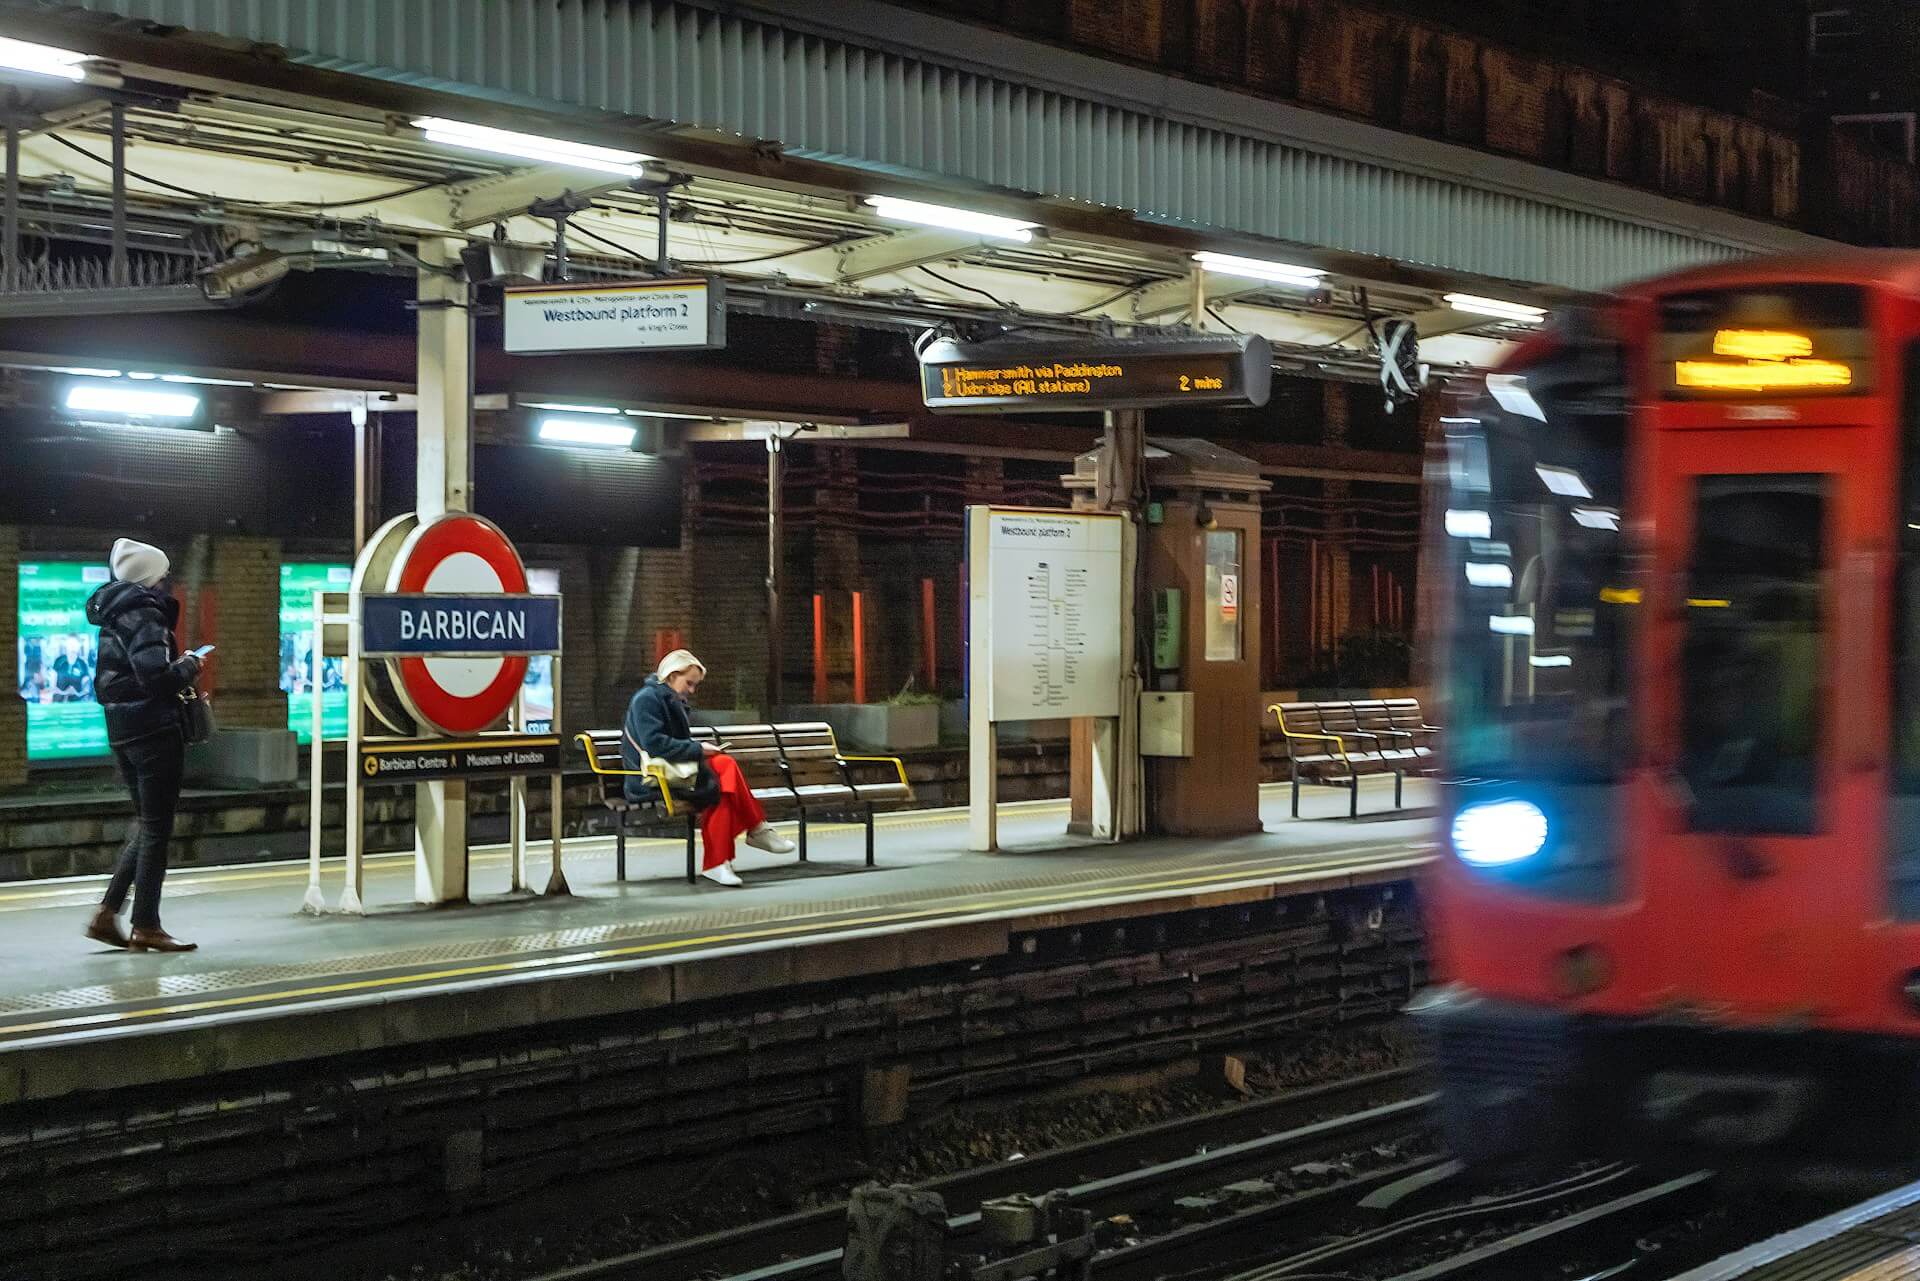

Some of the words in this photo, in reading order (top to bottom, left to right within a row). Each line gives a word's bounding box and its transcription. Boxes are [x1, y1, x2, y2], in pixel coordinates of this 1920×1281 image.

[544, 307, 616, 322] Westbound
[621, 305, 677, 322] platform
[681, 303, 688, 317] 2
[955, 365, 1034, 381] Hammersmith
[1035, 366, 1053, 378] via
[1054, 363, 1122, 378] Paddington
[957, 382, 1012, 396] Uxbridge
[1039, 379, 1090, 394] stations)
[1179, 375, 1191, 391] 2
[1194, 376, 1223, 390] mins
[400, 610, 526, 640] BARBICAN
[379, 758, 416, 771] Barbican
[418, 757, 448, 770] Centre
[467, 754, 501, 767] Museum
[503, 752, 513, 765] of
[514, 751, 545, 764] London
